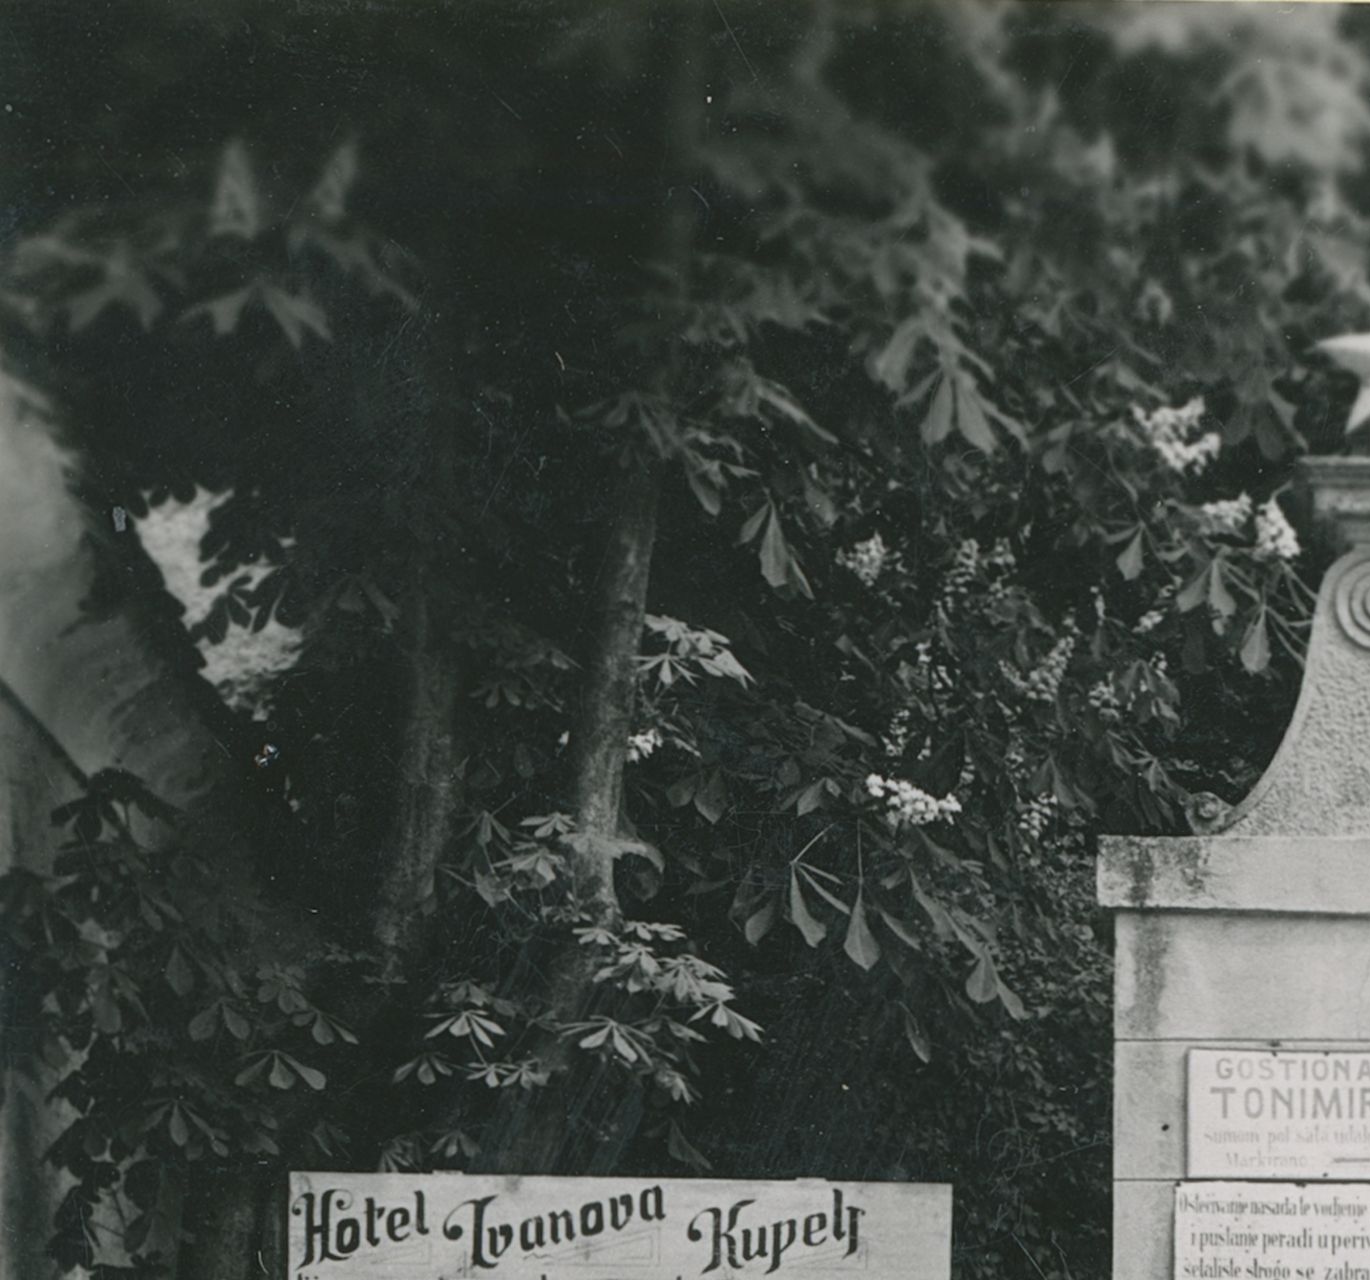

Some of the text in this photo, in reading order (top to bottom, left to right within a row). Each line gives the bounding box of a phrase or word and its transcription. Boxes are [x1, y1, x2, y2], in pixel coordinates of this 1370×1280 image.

[292, 1185, 866, 1275] Hotel Ivanova Kupelj
[1262, 1227, 1313, 1255] peradi
[1318, 1234, 1328, 1249] u
[1295, 1266, 1315, 1280] se
